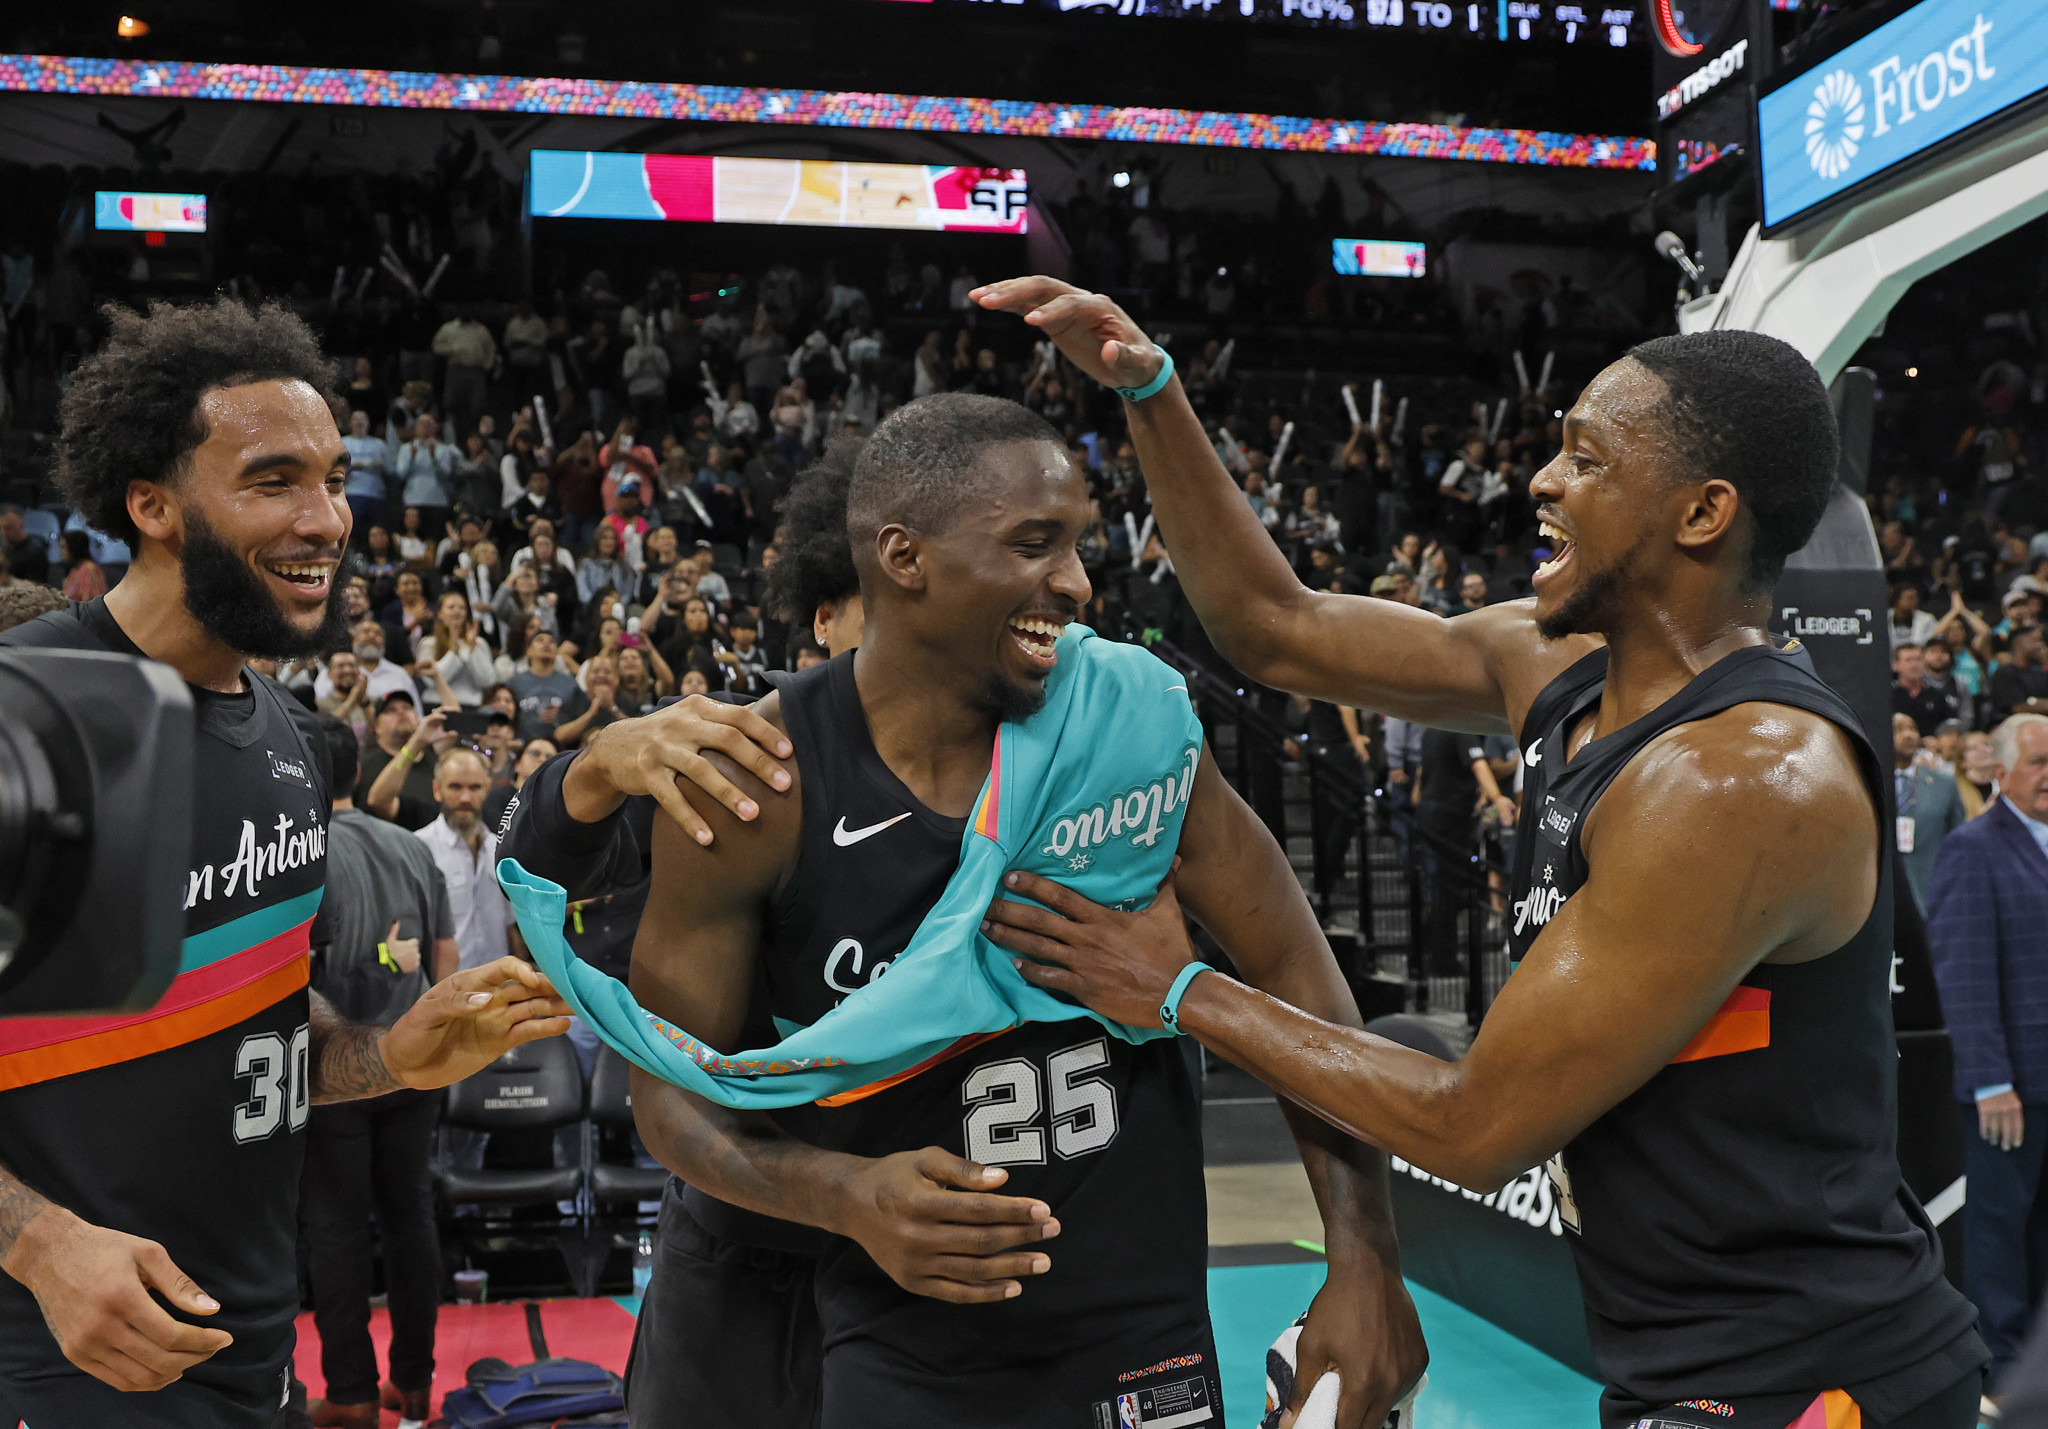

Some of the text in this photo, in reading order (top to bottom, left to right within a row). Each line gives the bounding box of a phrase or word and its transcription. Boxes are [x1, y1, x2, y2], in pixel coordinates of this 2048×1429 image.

[1411, 2, 1452, 28] TO
[1679, 38, 1749, 105] TISSOT
[1868, 13, 1996, 138] Frost
[1795, 616, 1861, 635] LEDGER
[274, 759, 306, 780] LEDGER
[219, 812, 326, 898] Antonio
[232, 1021, 312, 1145] 30
[961, 1035, 1121, 1168] 25
